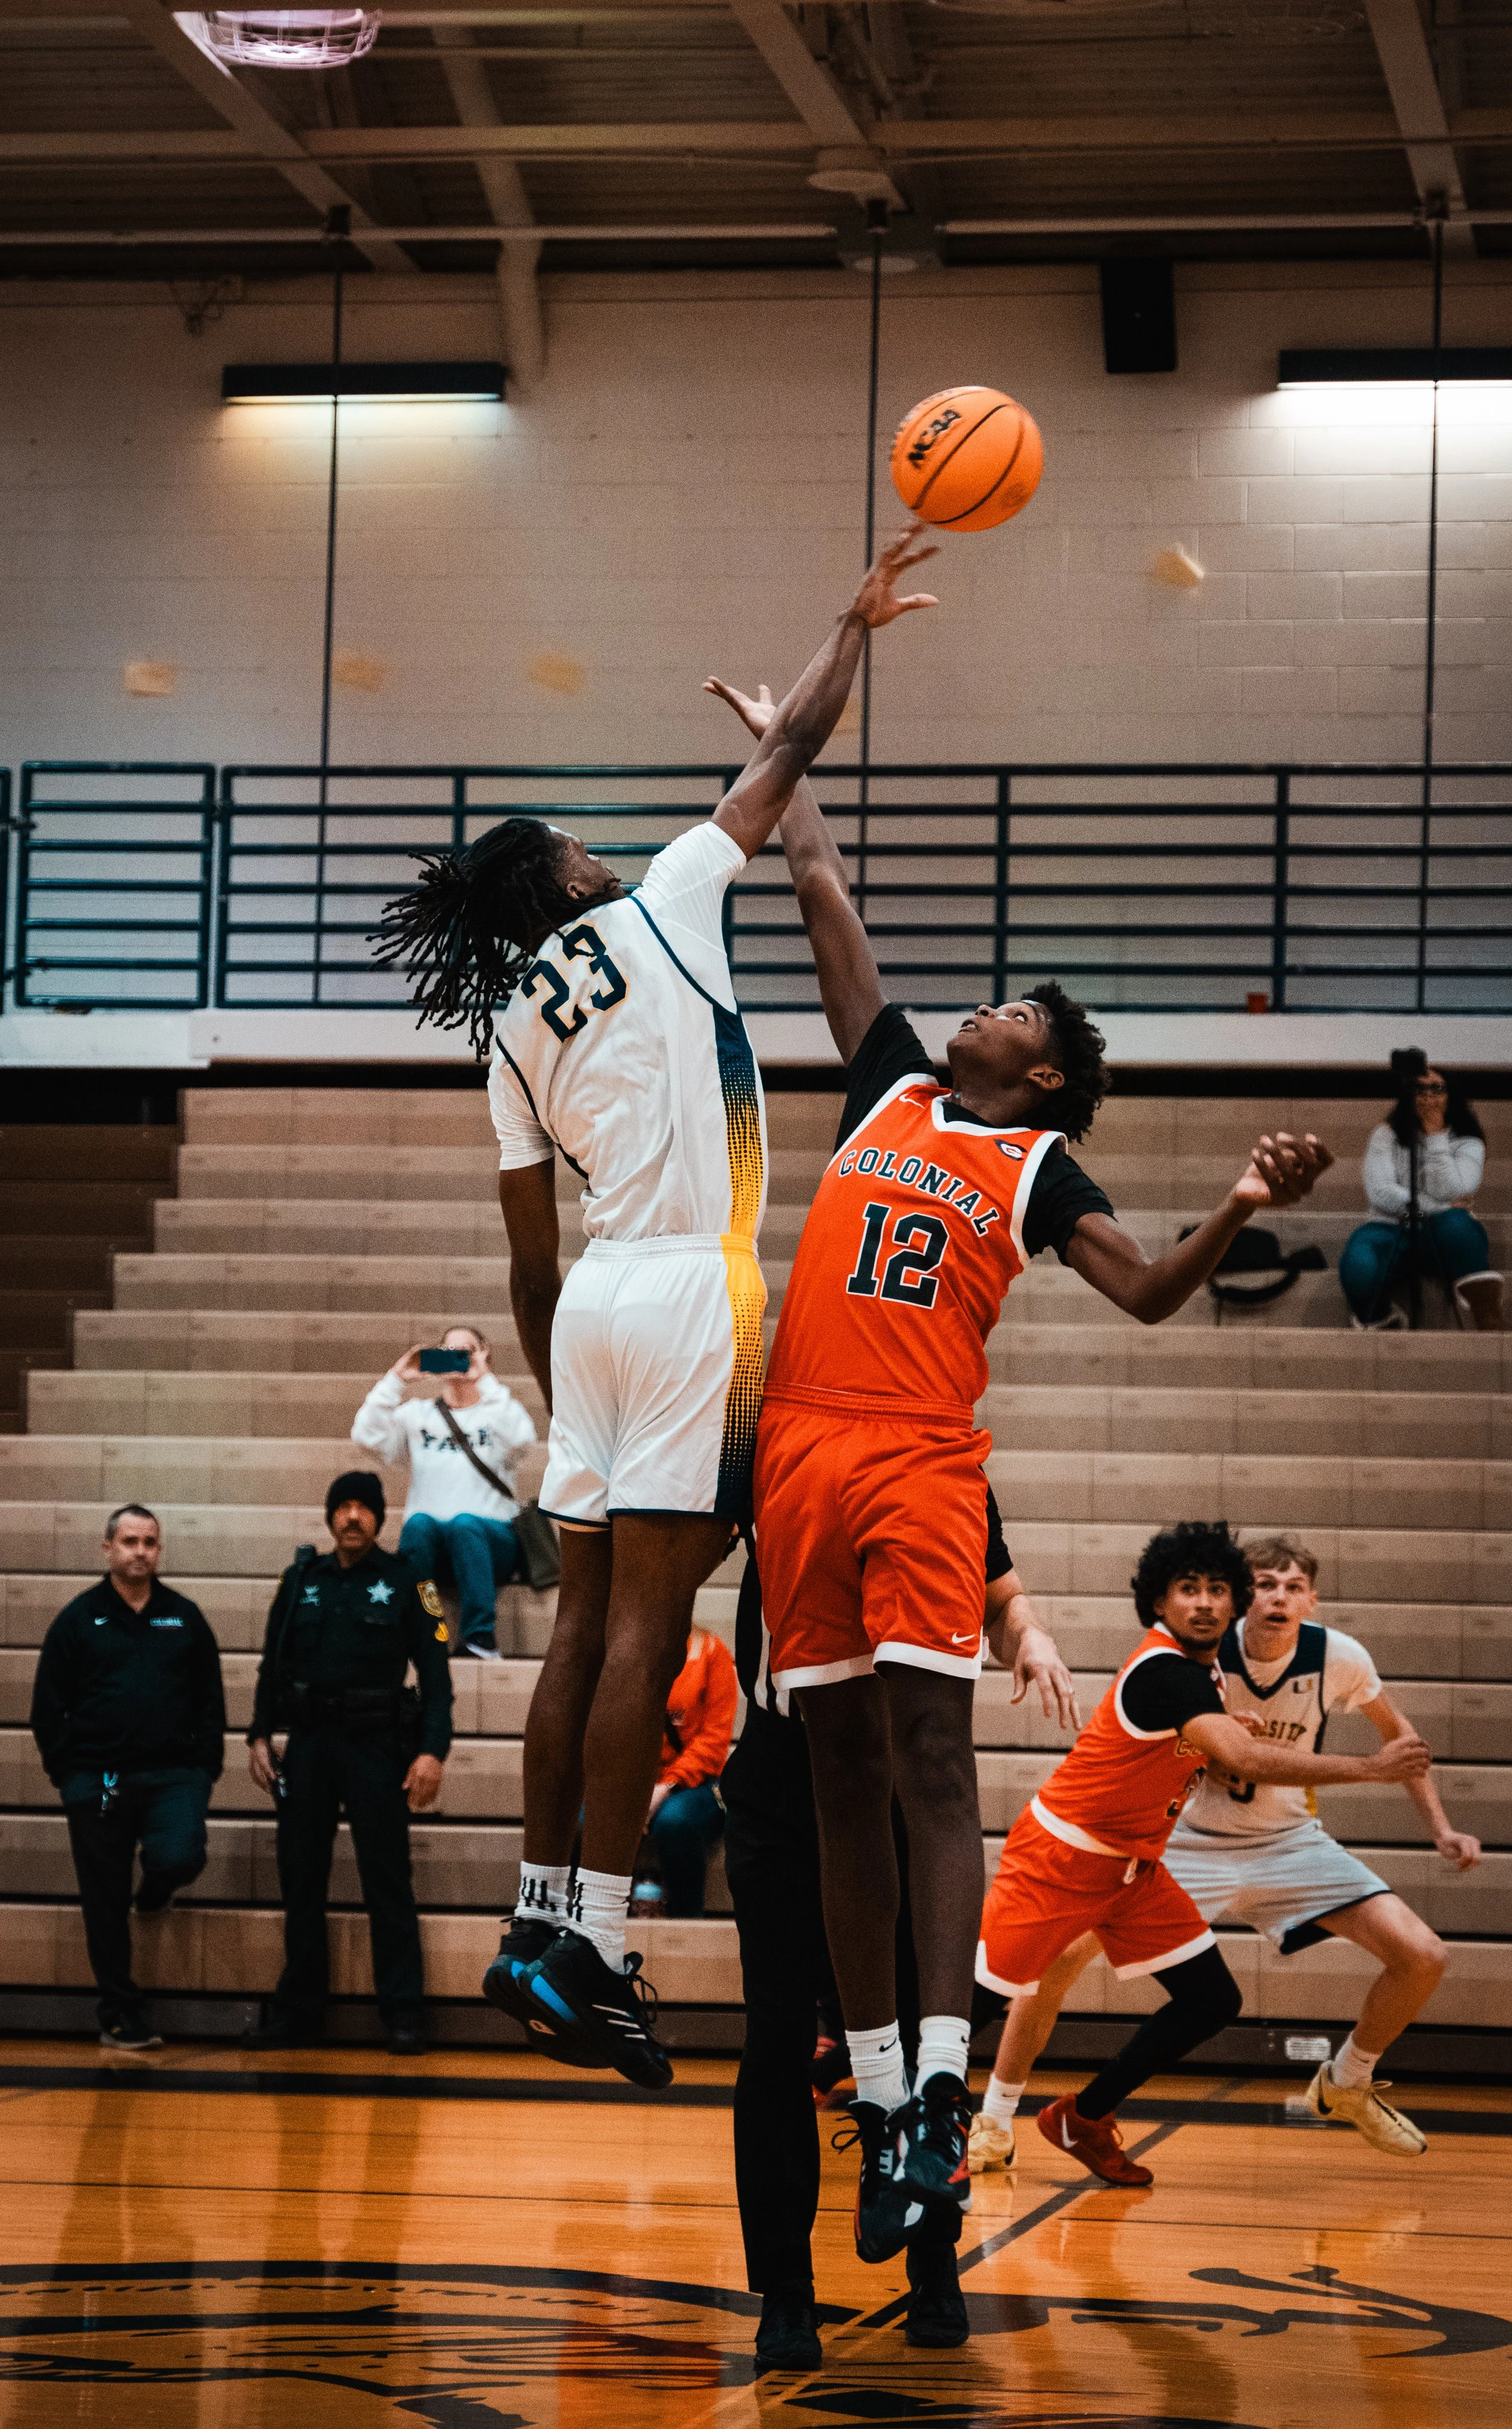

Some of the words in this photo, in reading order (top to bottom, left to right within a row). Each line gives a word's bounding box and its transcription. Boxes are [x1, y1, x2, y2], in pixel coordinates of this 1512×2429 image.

[520, 922, 628, 1043] 23
[839, 1147, 999, 1237] COLONIAL
[847, 1202, 949, 1309] 12
